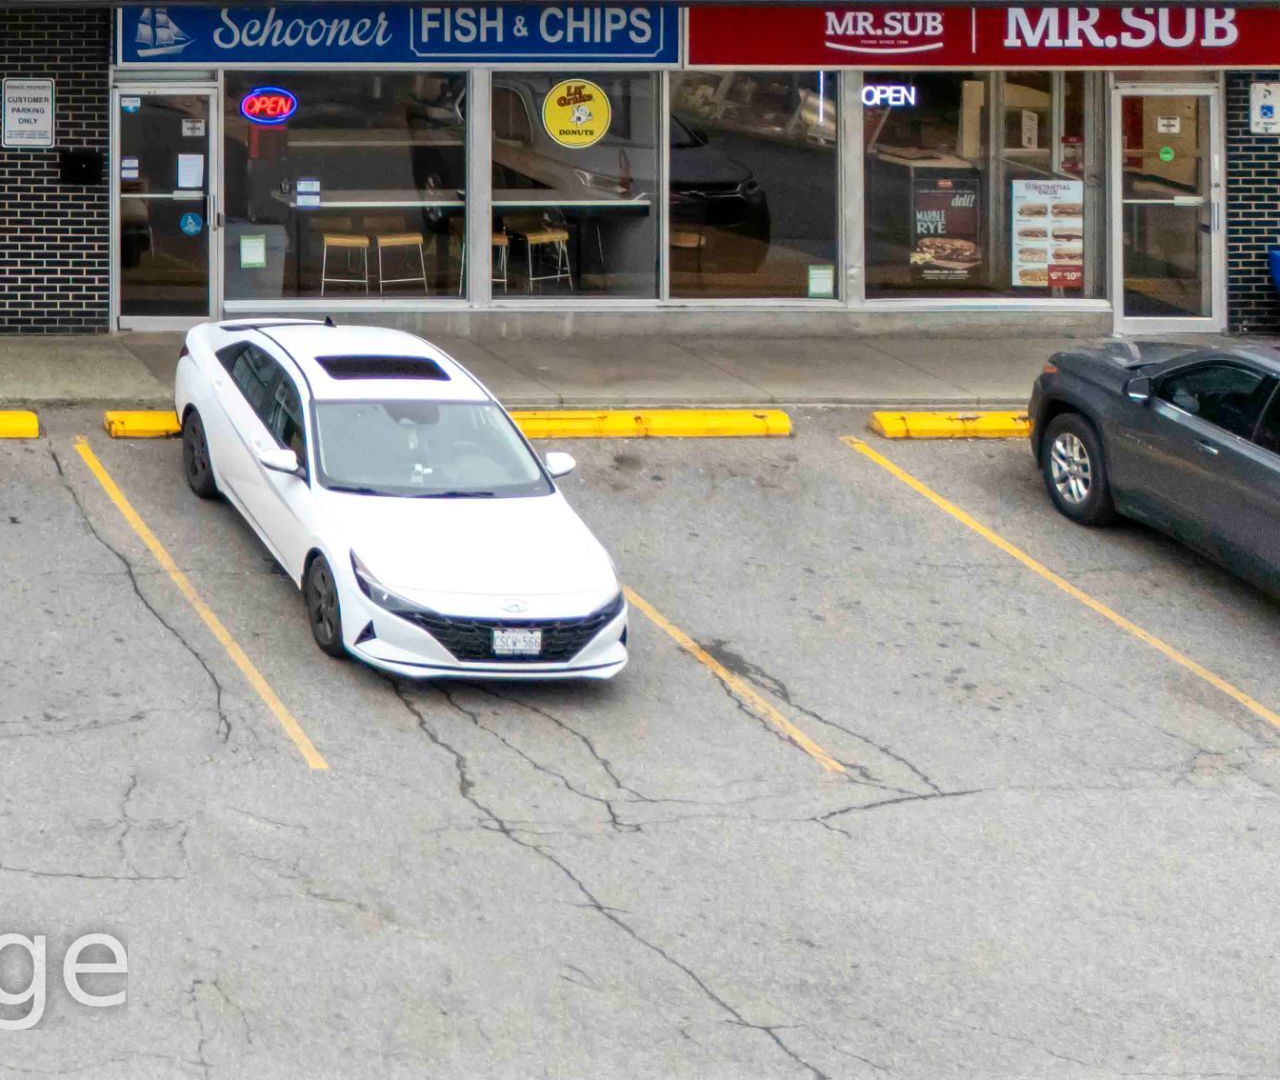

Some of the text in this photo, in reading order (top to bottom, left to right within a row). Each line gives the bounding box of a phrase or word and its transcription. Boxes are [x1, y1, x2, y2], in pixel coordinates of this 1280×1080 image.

[212, 9, 393, 49] Schooner
[421, 7, 653, 44] FISH & CHIPS
[825, 11, 944, 36] MR.SUB
[1003, 8, 1239, 49] MR.SUB
[244, 95, 292, 116] OPEN
[861, 85, 916, 106] OPEN
[18, 117, 38, 125] ONLY
[915, 210, 946, 221] MARBLE
[916, 221, 947, 234] RYE
